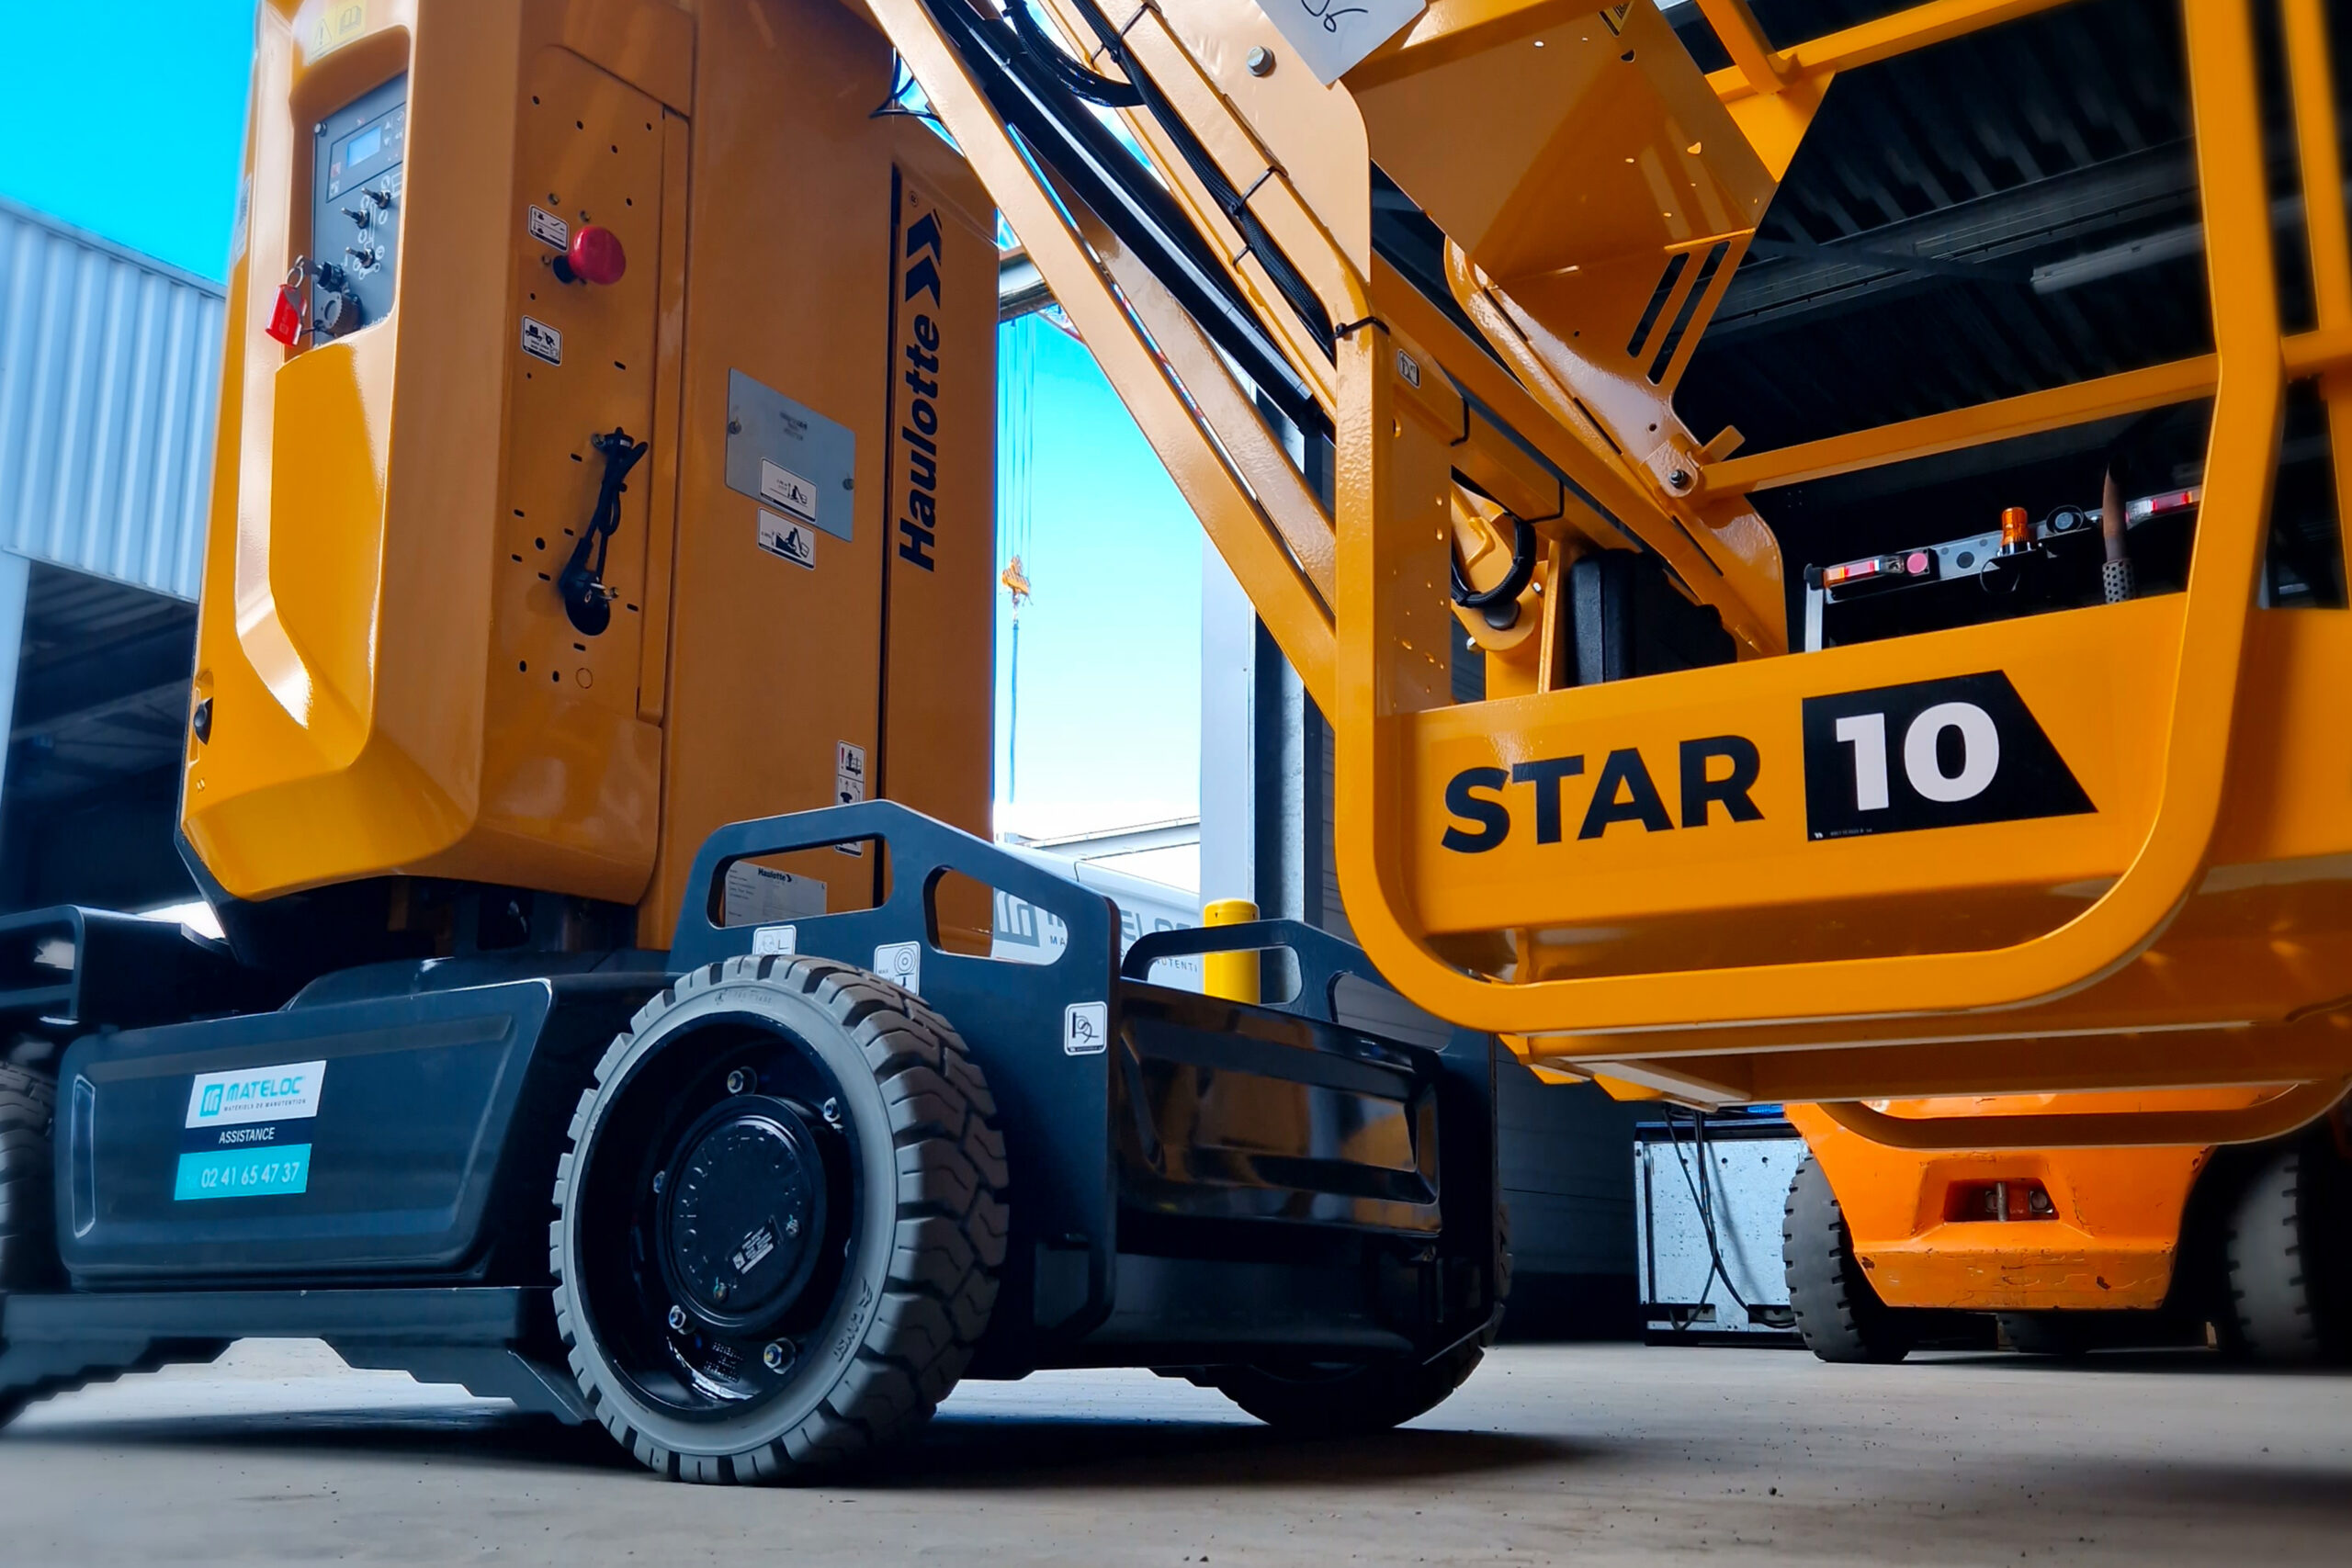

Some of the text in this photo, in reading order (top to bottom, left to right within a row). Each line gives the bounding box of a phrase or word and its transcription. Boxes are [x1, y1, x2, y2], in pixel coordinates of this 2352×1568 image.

[899, 314, 940, 572] Haulotte
[1441, 702, 2000, 854] STAR 10
[226, 1076, 303, 1101] MATELOC
[219, 1127, 275, 1145] ASSISTANCE
[201, 1161, 300, 1188] 02 41 65 47 37
